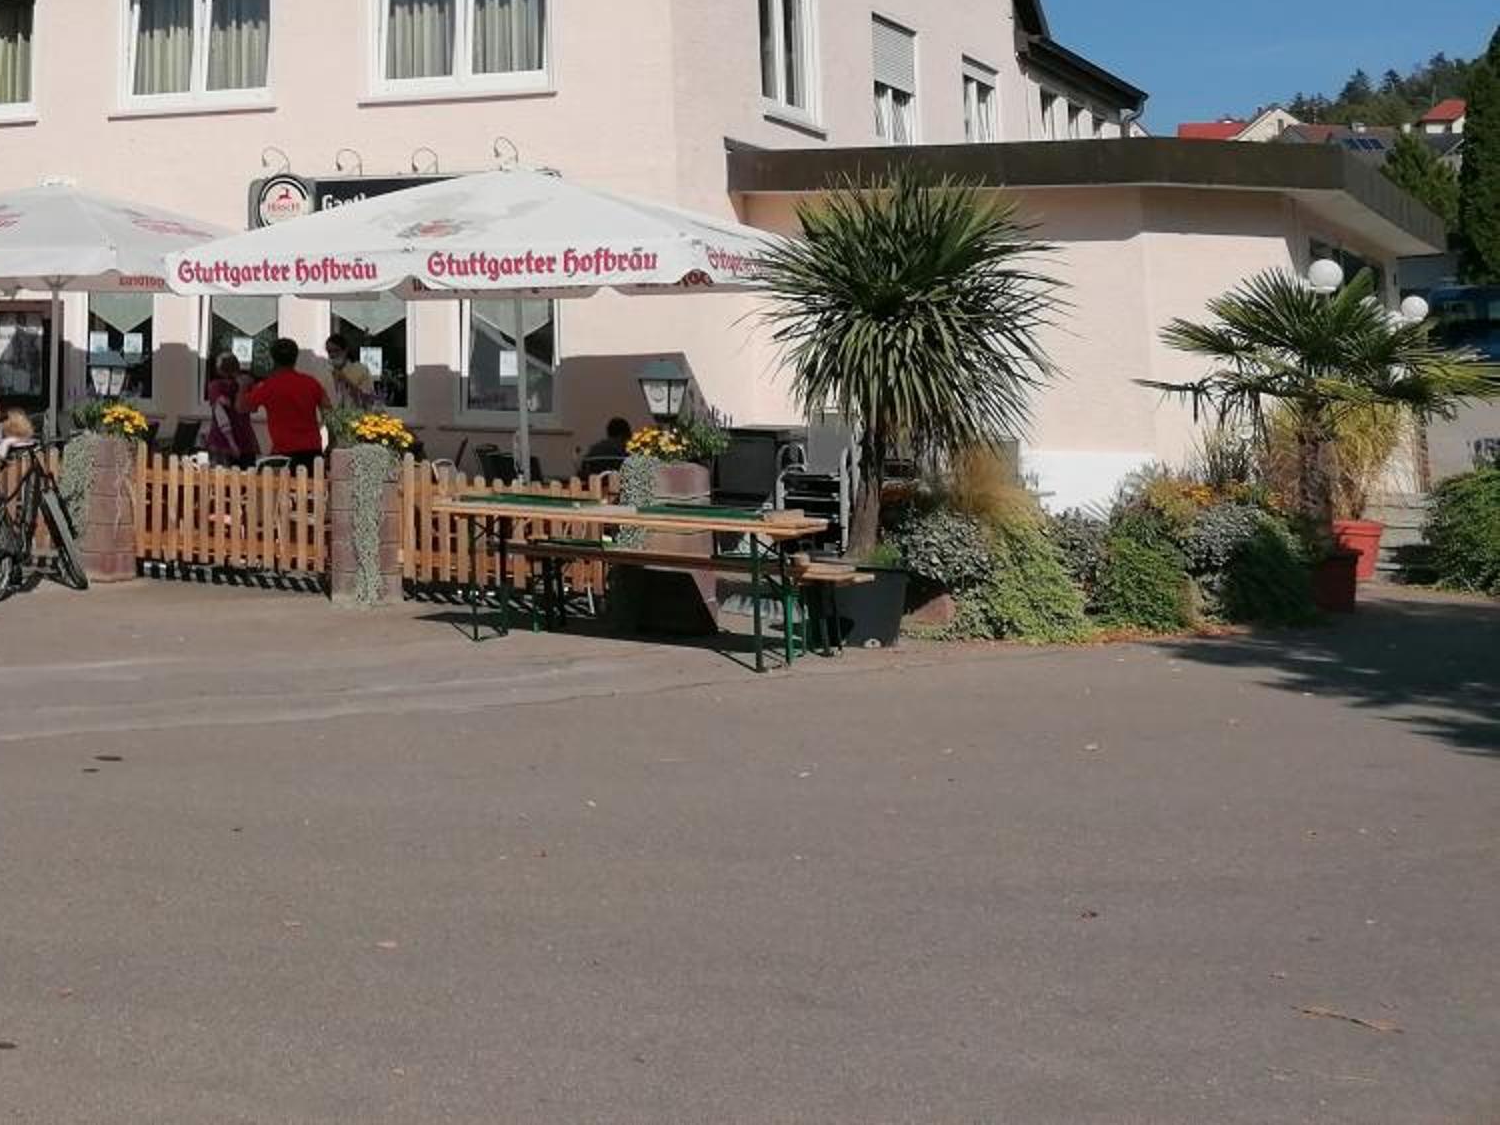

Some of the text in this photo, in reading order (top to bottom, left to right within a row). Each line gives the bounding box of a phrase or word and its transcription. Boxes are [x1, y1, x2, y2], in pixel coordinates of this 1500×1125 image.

[177, 258, 290, 288] Stuttgarter
[295, 256, 378, 286] Hofbräu
[427, 247, 658, 281] Stuttgarter Hofbräu
